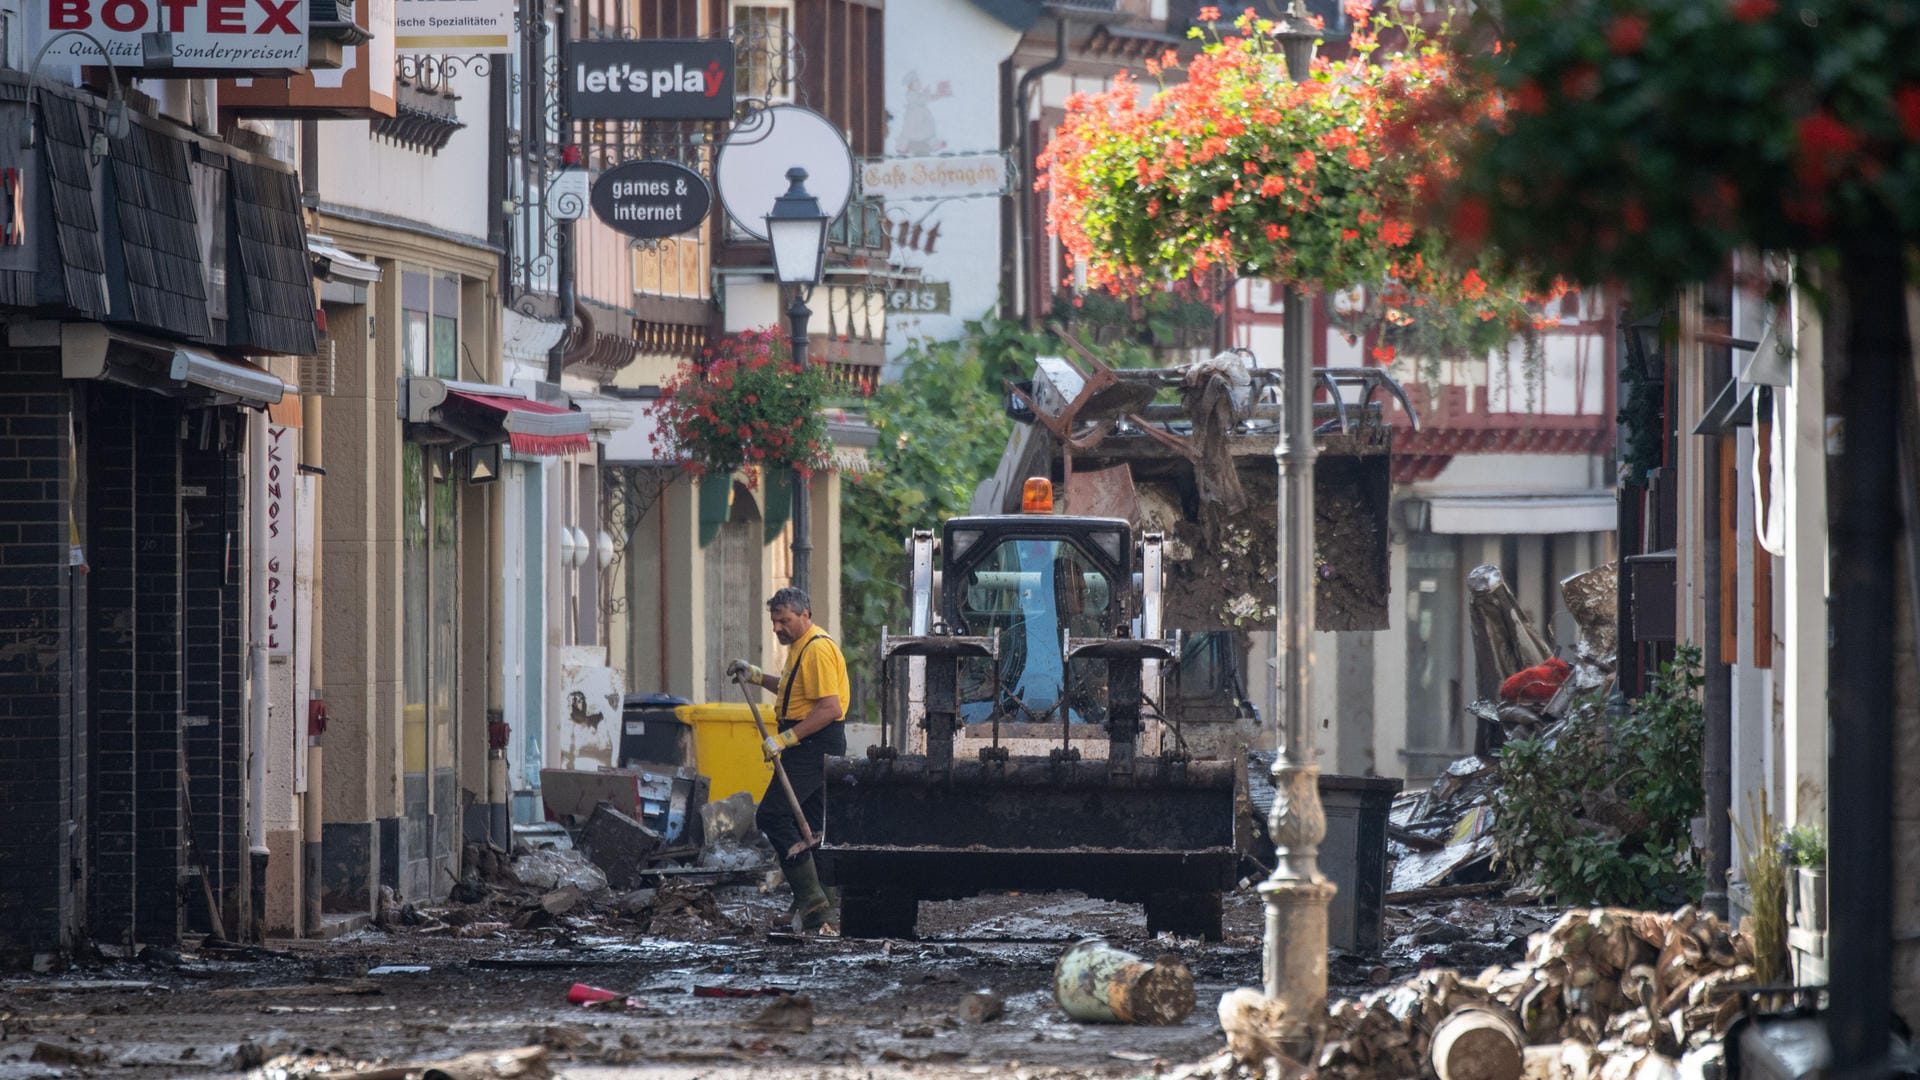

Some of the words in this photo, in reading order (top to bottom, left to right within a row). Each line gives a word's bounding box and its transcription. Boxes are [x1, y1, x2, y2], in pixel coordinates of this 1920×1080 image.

[48, 0, 303, 34] BOTEX
[428, 16, 497, 28] Spezialitäten
[69, 41, 142, 56] Qualität
[172, 42, 304, 62] Sonderpreisen!
[651, 61, 724, 98] play
[612, 180, 670, 199] games
[675, 179, 688, 196] &
[614, 203, 682, 220] internet
